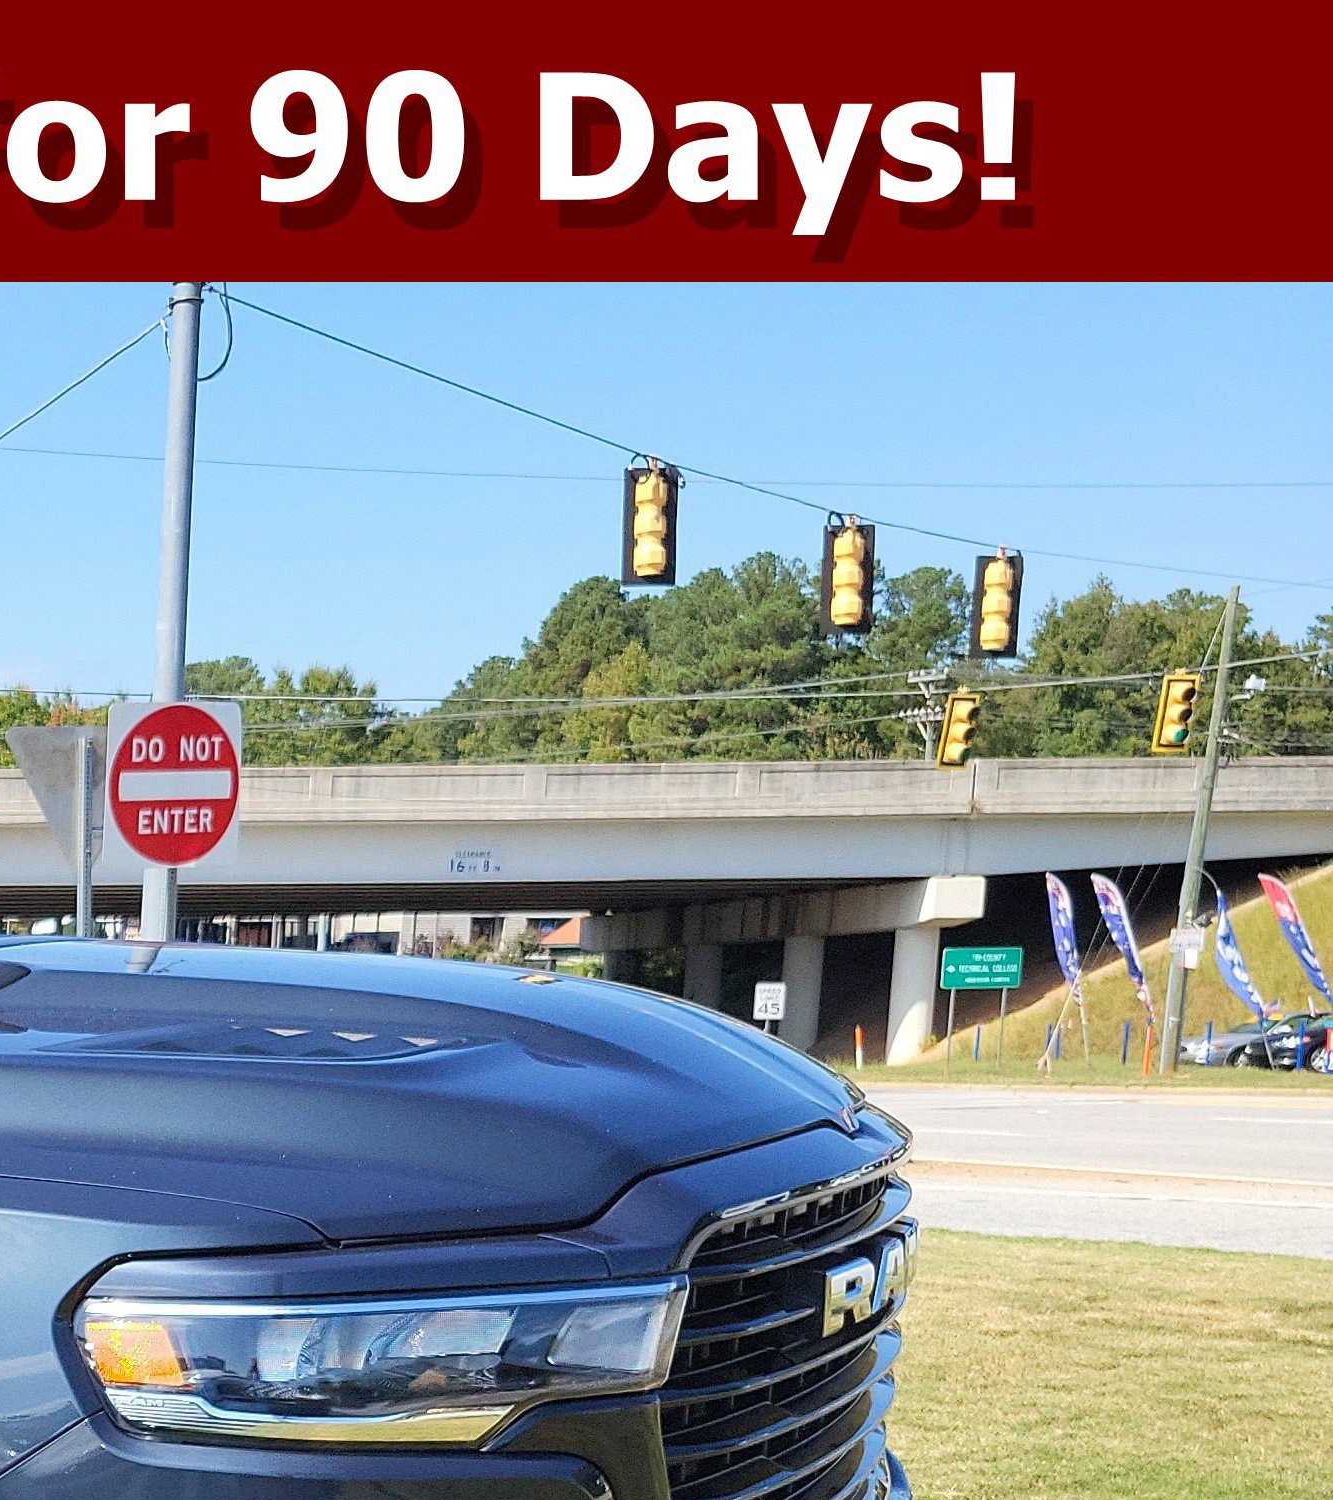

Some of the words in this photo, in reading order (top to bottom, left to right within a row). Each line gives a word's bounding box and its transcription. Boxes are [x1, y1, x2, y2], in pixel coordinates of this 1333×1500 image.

[131, 736, 165, 763] DO
[179, 734, 225, 762] NOT
[137, 807, 214, 835] ENTER
[450, 859, 465, 872] 16
[757, 1003, 780, 1015] 45
